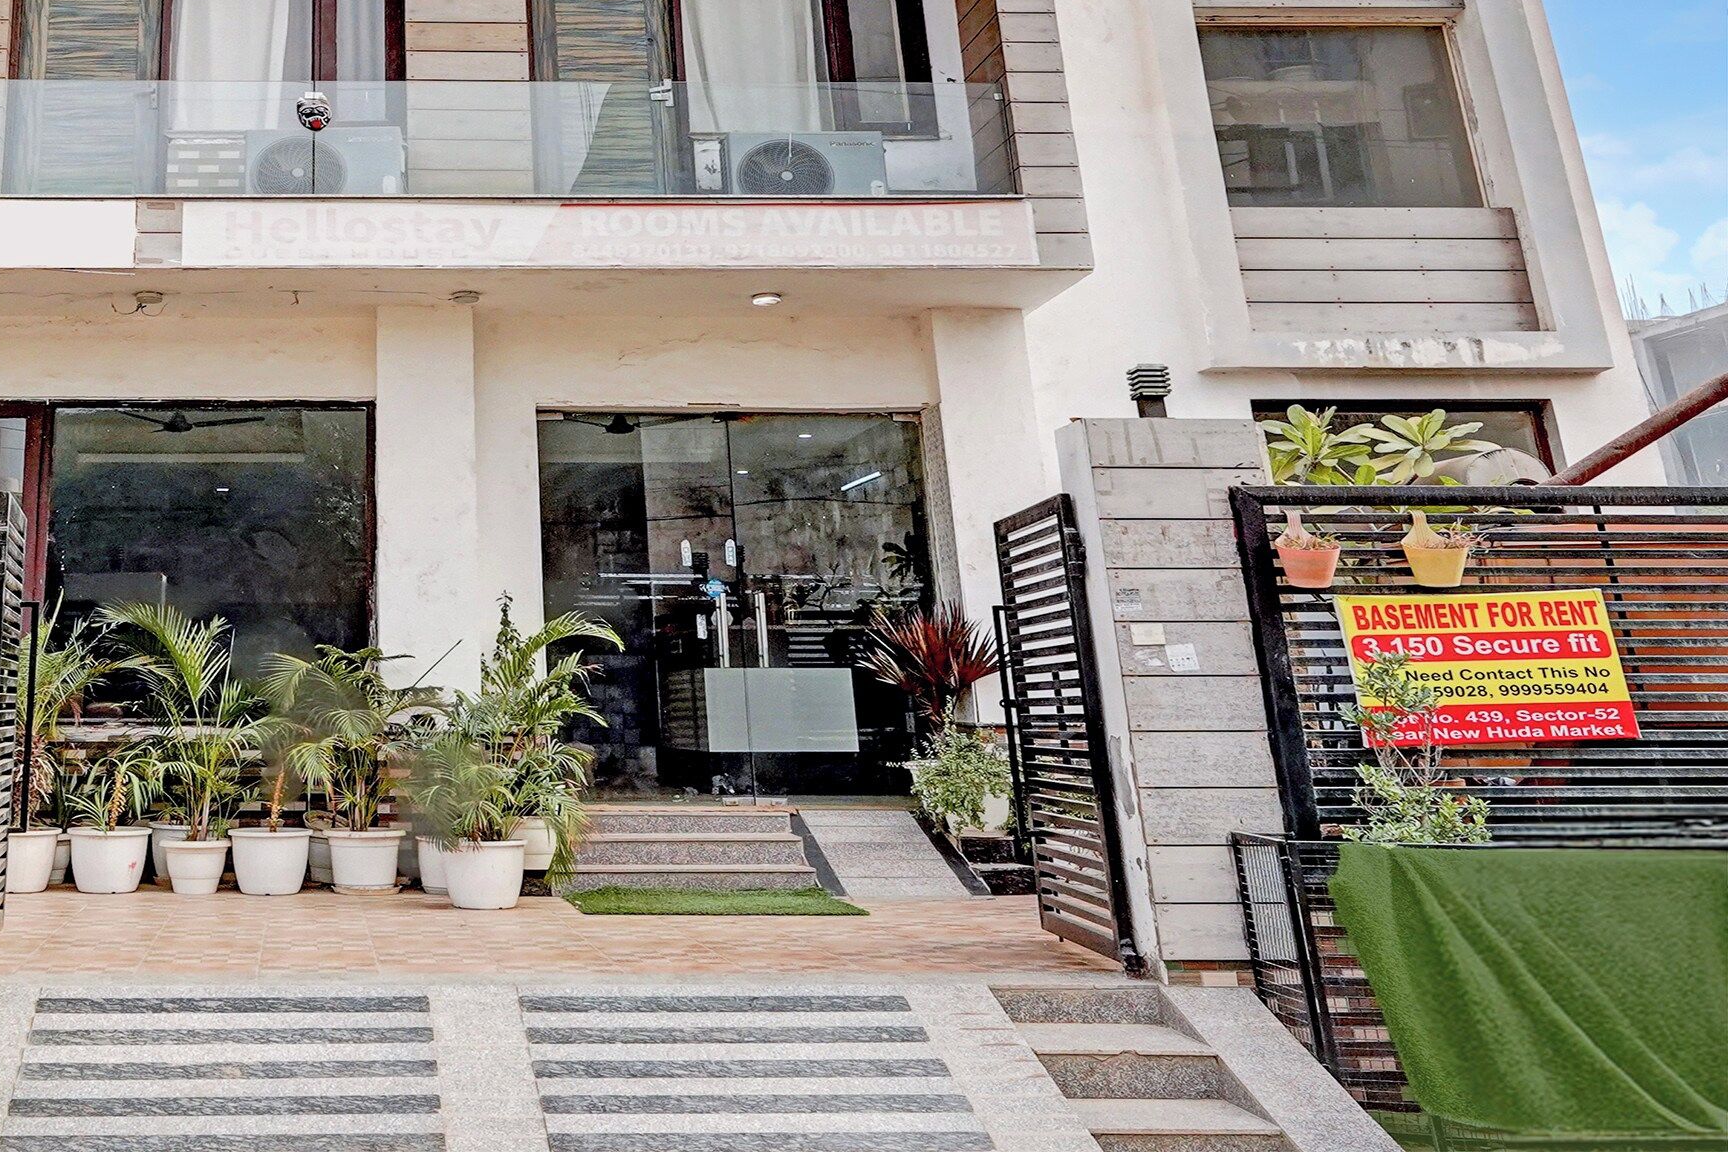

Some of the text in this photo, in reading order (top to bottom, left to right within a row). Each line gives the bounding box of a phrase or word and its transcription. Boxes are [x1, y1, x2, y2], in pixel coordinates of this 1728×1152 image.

[224, 207, 504, 251] Hellostay
[580, 207, 1004, 238] ROOMS AVAILABLE
[1352, 600, 1601, 631] BASEMENT FOR RENT
[1452, 634, 1560, 657] Secure
[1566, 633, 1602, 654] fit
[1404, 666, 1611, 683] Need Contact This No
[1499, 681, 1609, 697] 9999559404
[1423, 711, 1459, 725] No.
[1465, 709, 1511, 725] 439,
[1515, 707, 1621, 722] Sector-52
[1433, 726, 1481, 740] New
[1486, 724, 1545, 739] Huda
[1550, 722, 1626, 737] Market
